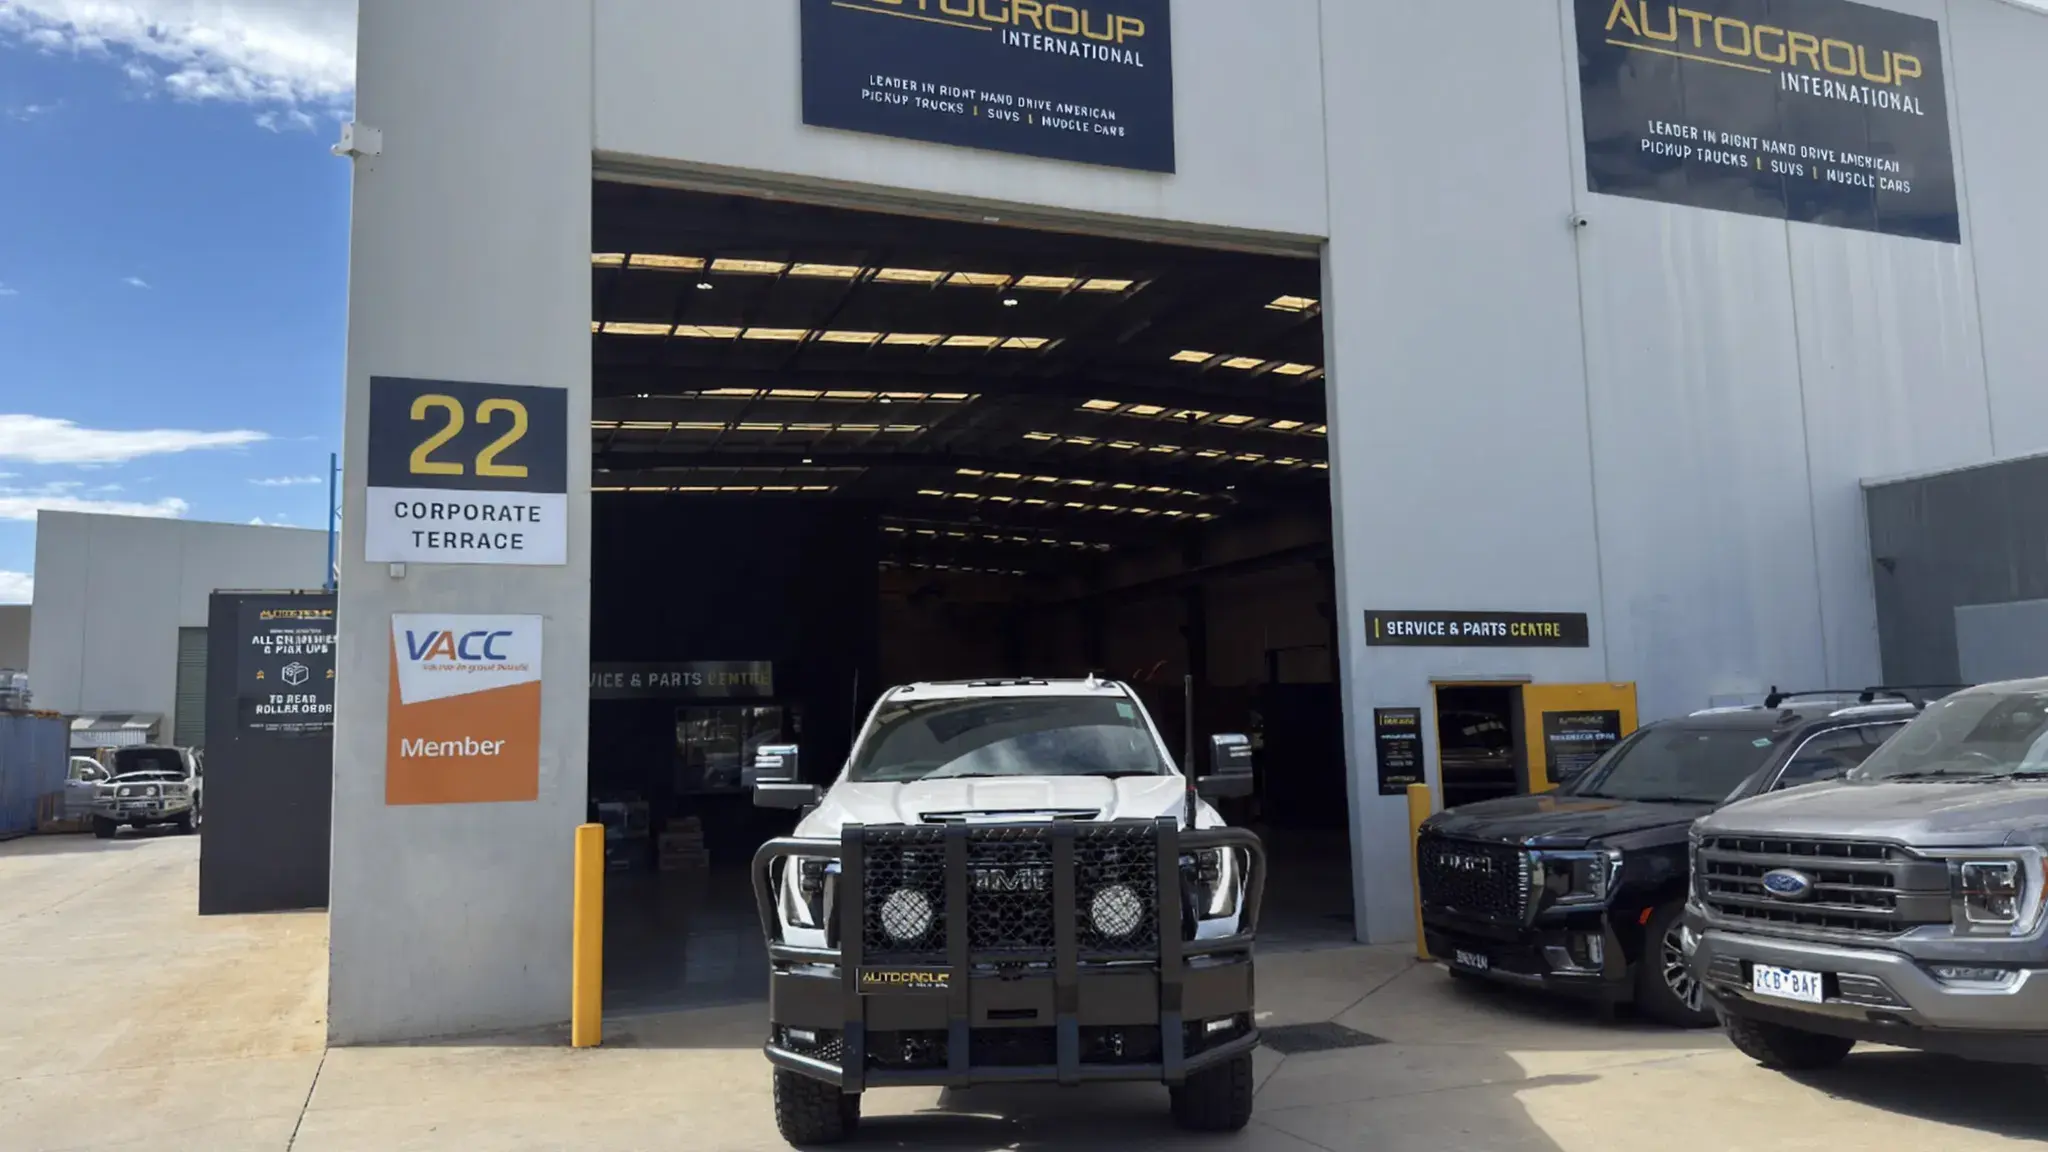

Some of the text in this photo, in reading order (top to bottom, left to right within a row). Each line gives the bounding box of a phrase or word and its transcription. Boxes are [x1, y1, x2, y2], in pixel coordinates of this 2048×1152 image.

[873, 0, 1145, 43] OGROUP
[1002, 29, 1144, 67] INTERNATIONAL
[1604, 0, 1922, 86] AUTOGROUP
[869, 74, 917, 91] LEADER
[921, 82, 935, 94] IN
[1780, 70, 1925, 115] INTERNATIONAL
[861, 88, 909, 105] PICKUP
[915, 97, 964, 114] TRUCKS
[987, 108, 1020, 122] SUVS
[1648, 120, 1698, 140] LEADER
[1703, 130, 1717, 144] IN
[1641, 138, 1692, 159] PICKUP
[1697, 148, 1748, 168] TRUCKS
[1771, 160, 1804, 176] SUVS
[1879, 177, 1911, 194] CARS
[409, 394, 529, 477] 22
[394, 501, 542, 523] CORPORATE
[411, 531, 524, 550] TERRACE
[1386, 621, 1561, 637] SERVICE & PARTS CENTRE
[405, 630, 513, 661] VACC
[589, 672, 624, 688] VICE
[630, 673, 642, 688] &
[648, 672, 703, 687] PARTS
[400, 736, 506, 757] Member
